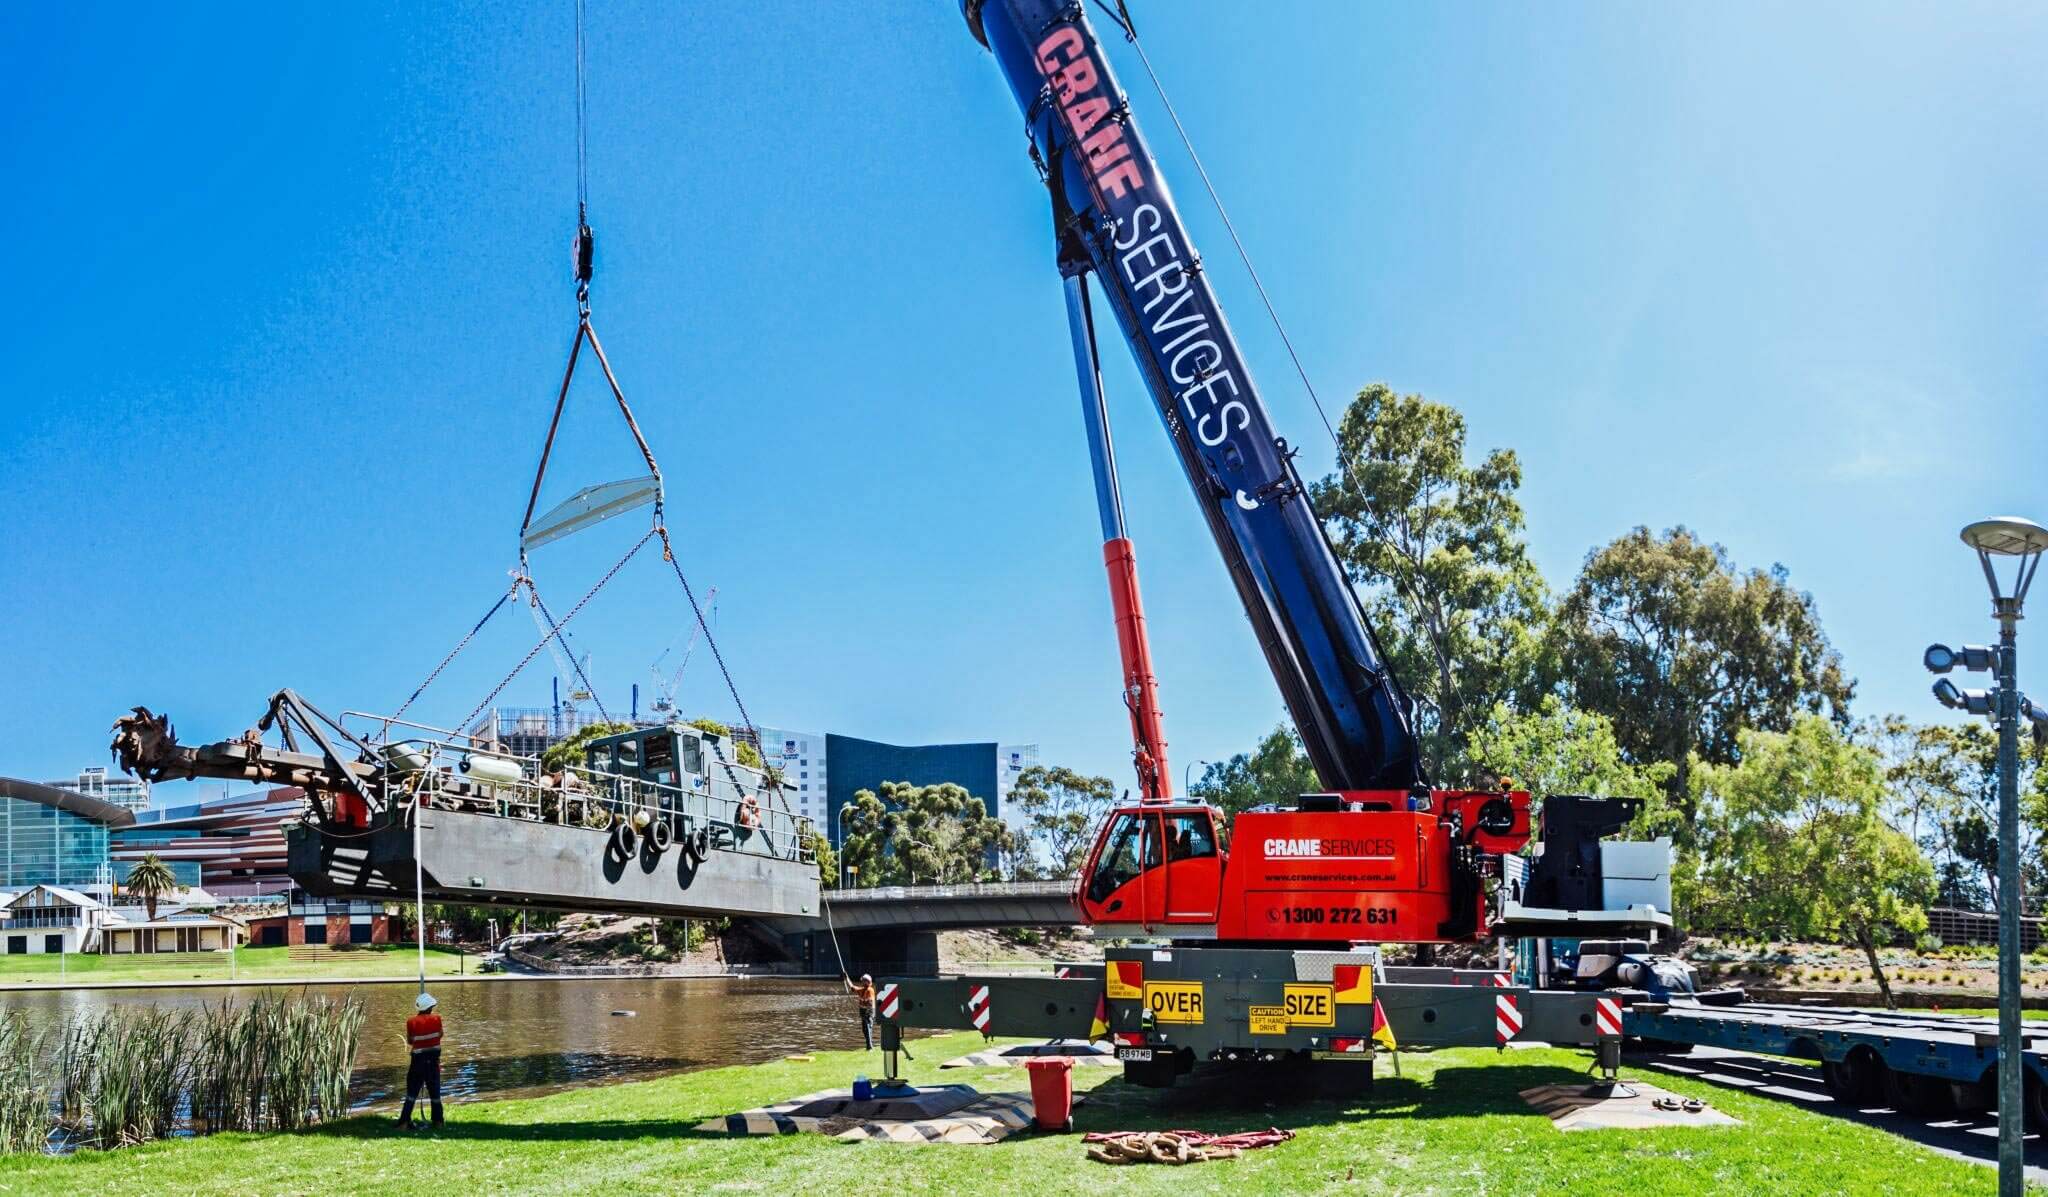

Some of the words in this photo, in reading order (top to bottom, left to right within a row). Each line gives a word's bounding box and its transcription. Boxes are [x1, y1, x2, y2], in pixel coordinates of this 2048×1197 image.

[1036, 27, 1144, 199] CRANE
[1112, 204, 1250, 446] SERVICES
[1264, 873, 1396, 882] www.craneservices.com.au
[1283, 908, 1324, 923] 1300
[1329, 908, 1361, 923] 272
[1367, 908, 1397, 923] 631
[1151, 991, 1202, 1013] OVER
[1286, 994, 1327, 1016] SIZE
[1252, 1008, 1284, 1016] CAUTION
